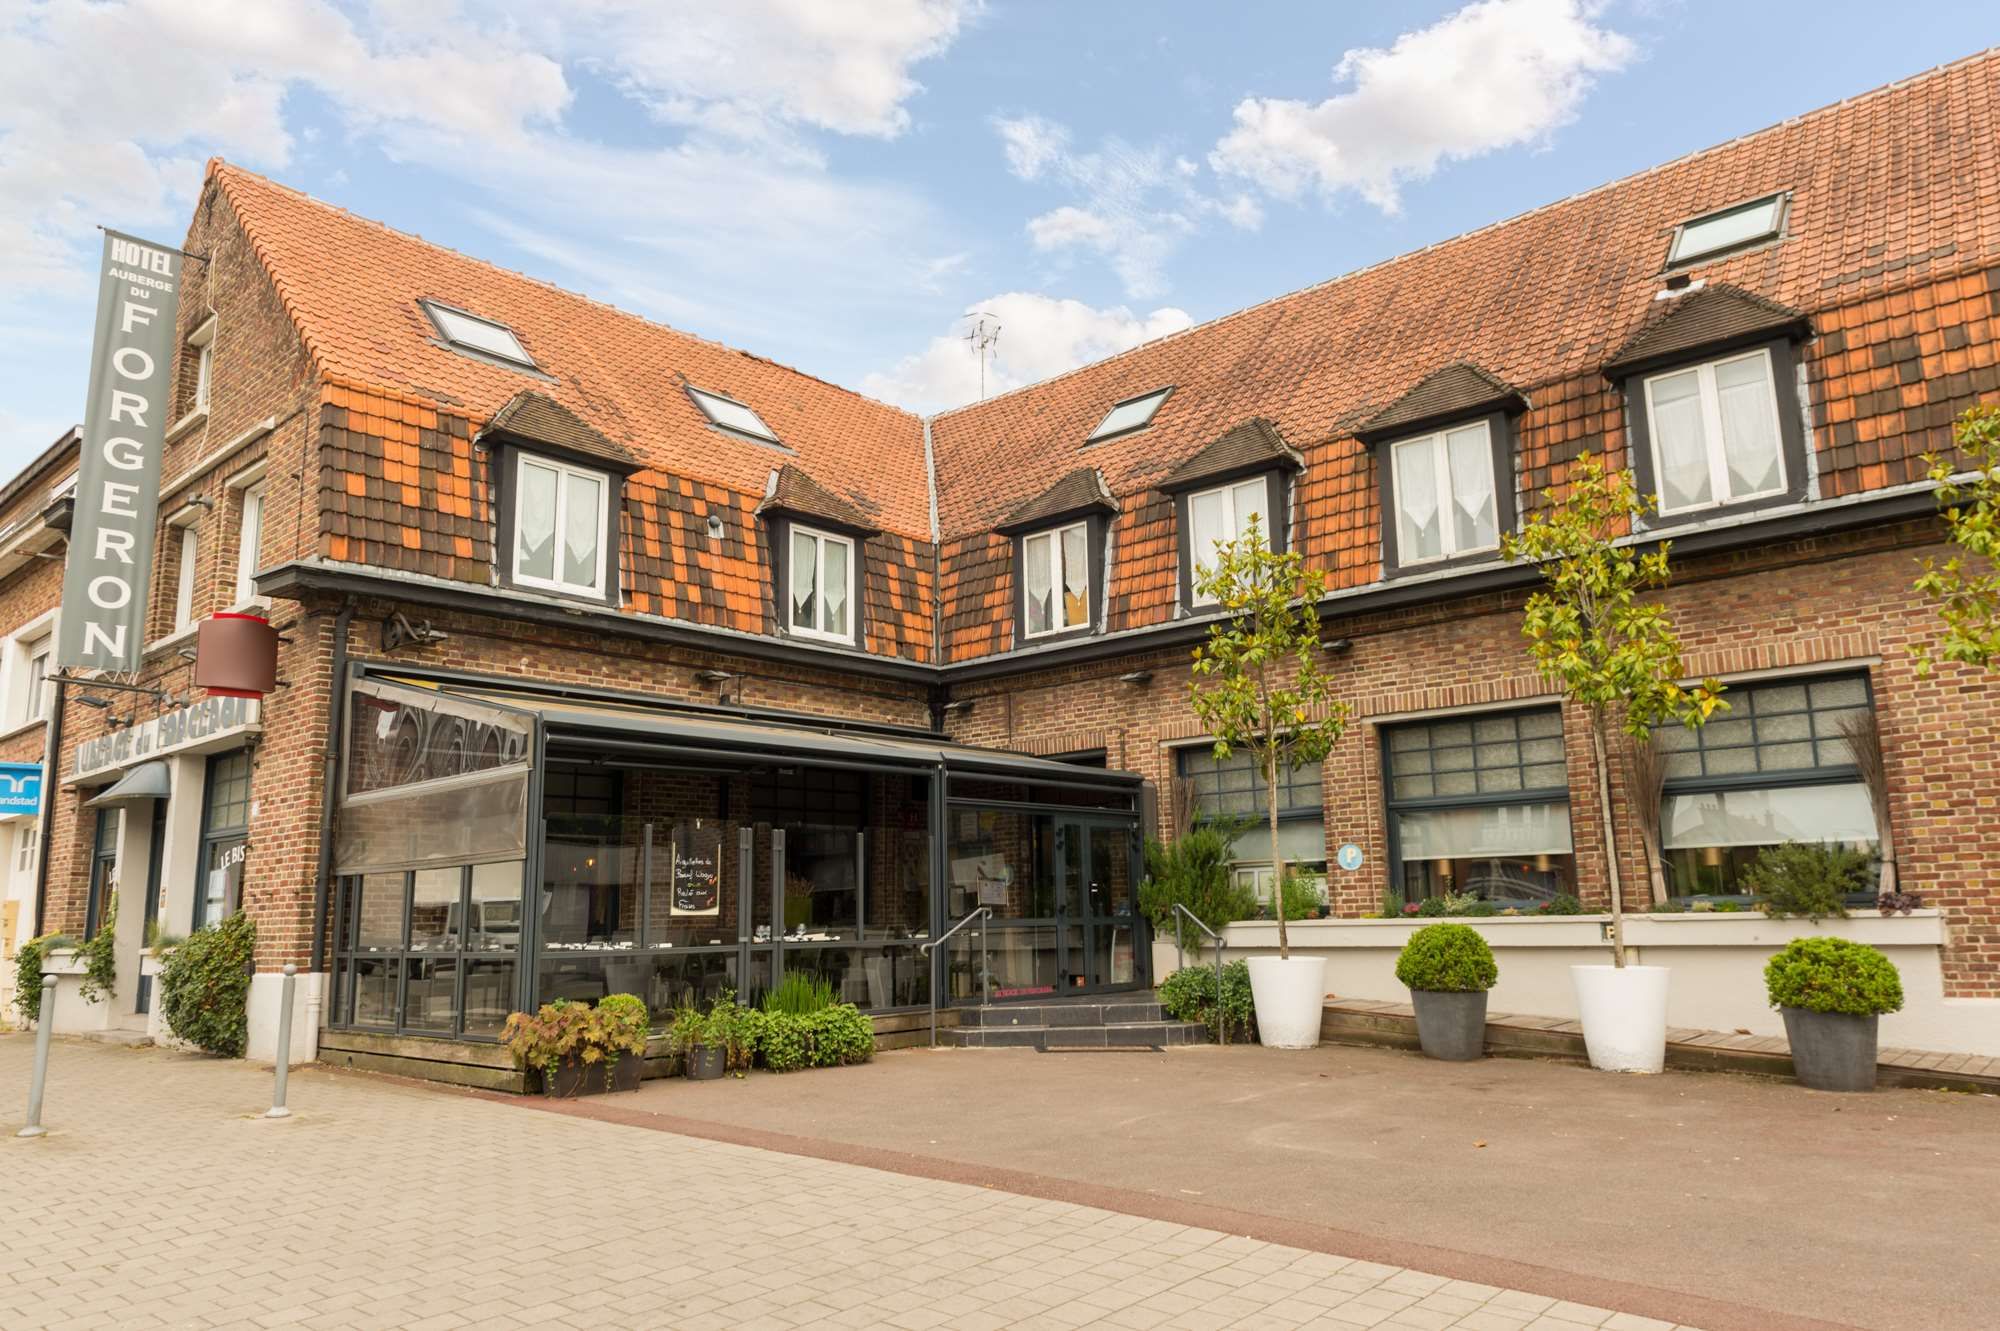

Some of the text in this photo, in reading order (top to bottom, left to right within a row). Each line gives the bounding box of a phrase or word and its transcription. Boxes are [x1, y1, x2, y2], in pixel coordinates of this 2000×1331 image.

[111, 238, 173, 277] HOTEL
[108, 267, 174, 293] AUBERGE
[130, 286, 150, 299] DU
[81, 301, 158, 658] FORGERON
[220, 851, 231, 870] LE
[1346, 847, 1356, 863] P
